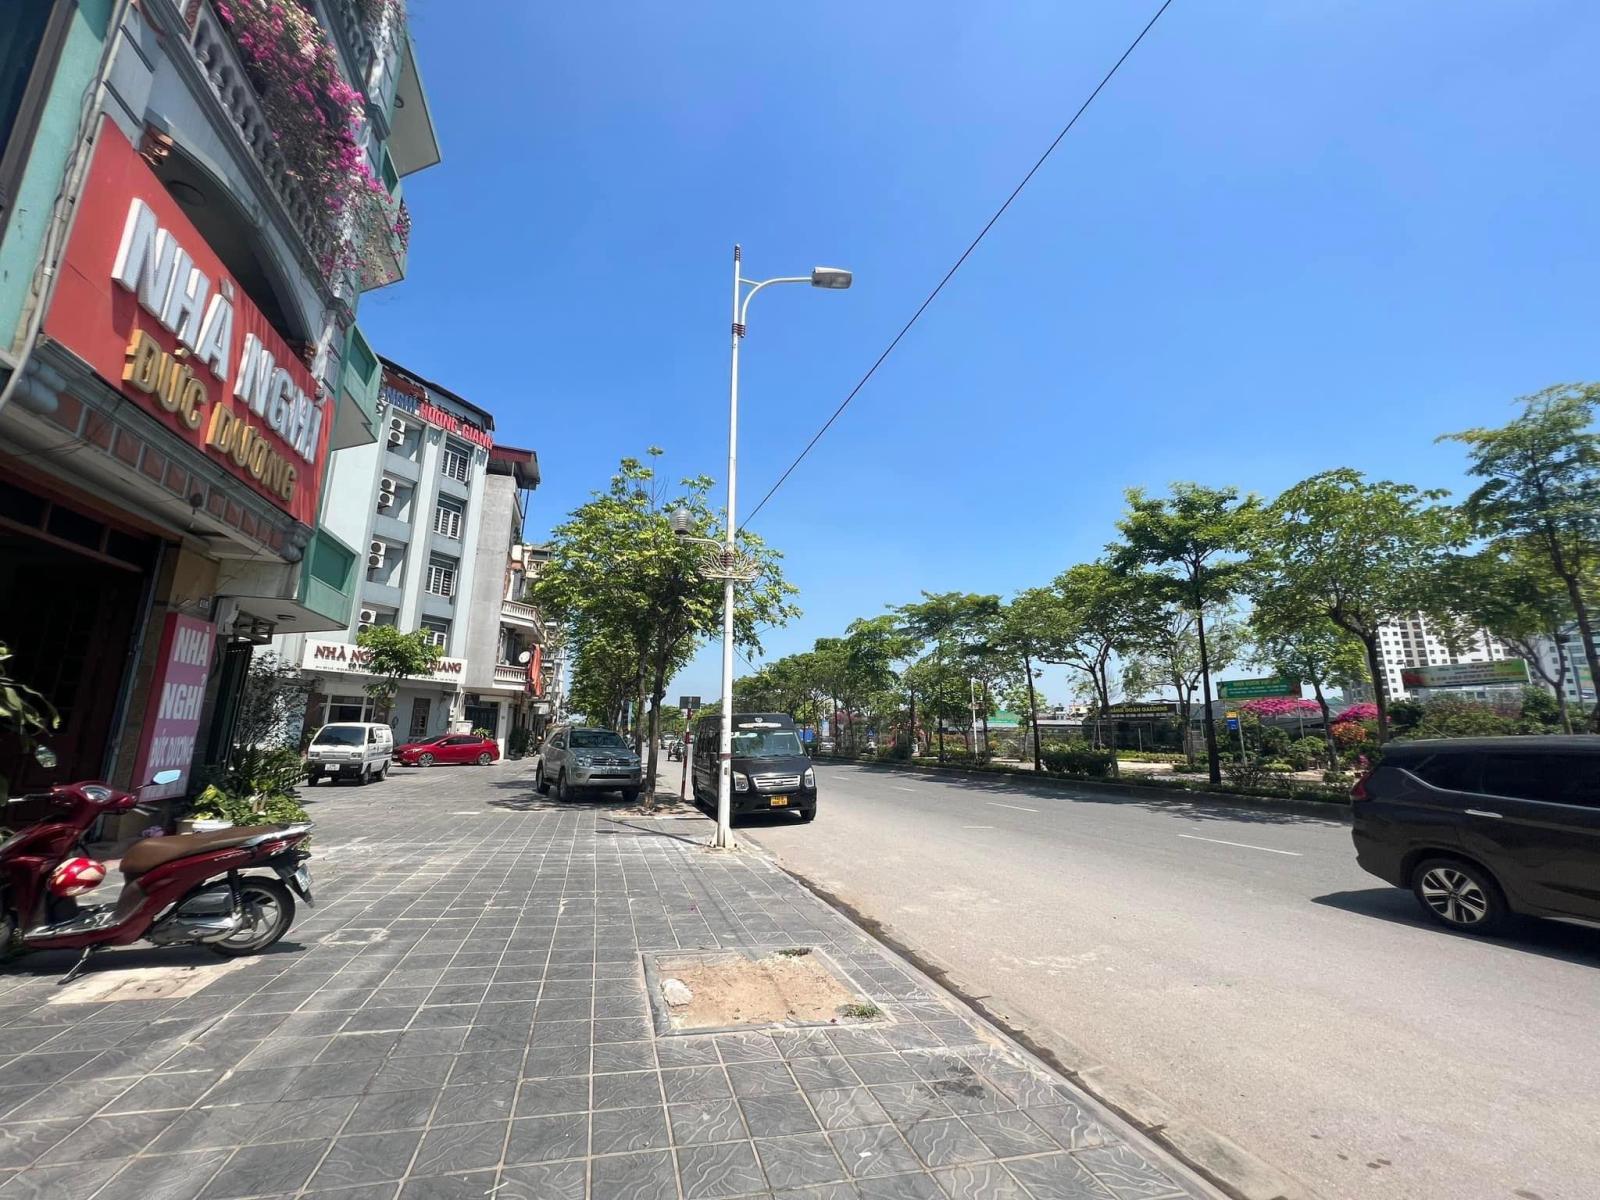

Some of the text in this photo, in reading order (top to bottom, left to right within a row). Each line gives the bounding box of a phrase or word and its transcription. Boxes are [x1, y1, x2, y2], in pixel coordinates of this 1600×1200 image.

[111, 197, 234, 382] NHÀ
[122, 329, 298, 500] ĐỨC DƯƠNG
[462, 423, 493, 450] GIANG
[174, 626, 210, 667] NHÀ
[314, 645, 347, 661] NHÀ
[159, 674, 207, 720] NGHỈ
